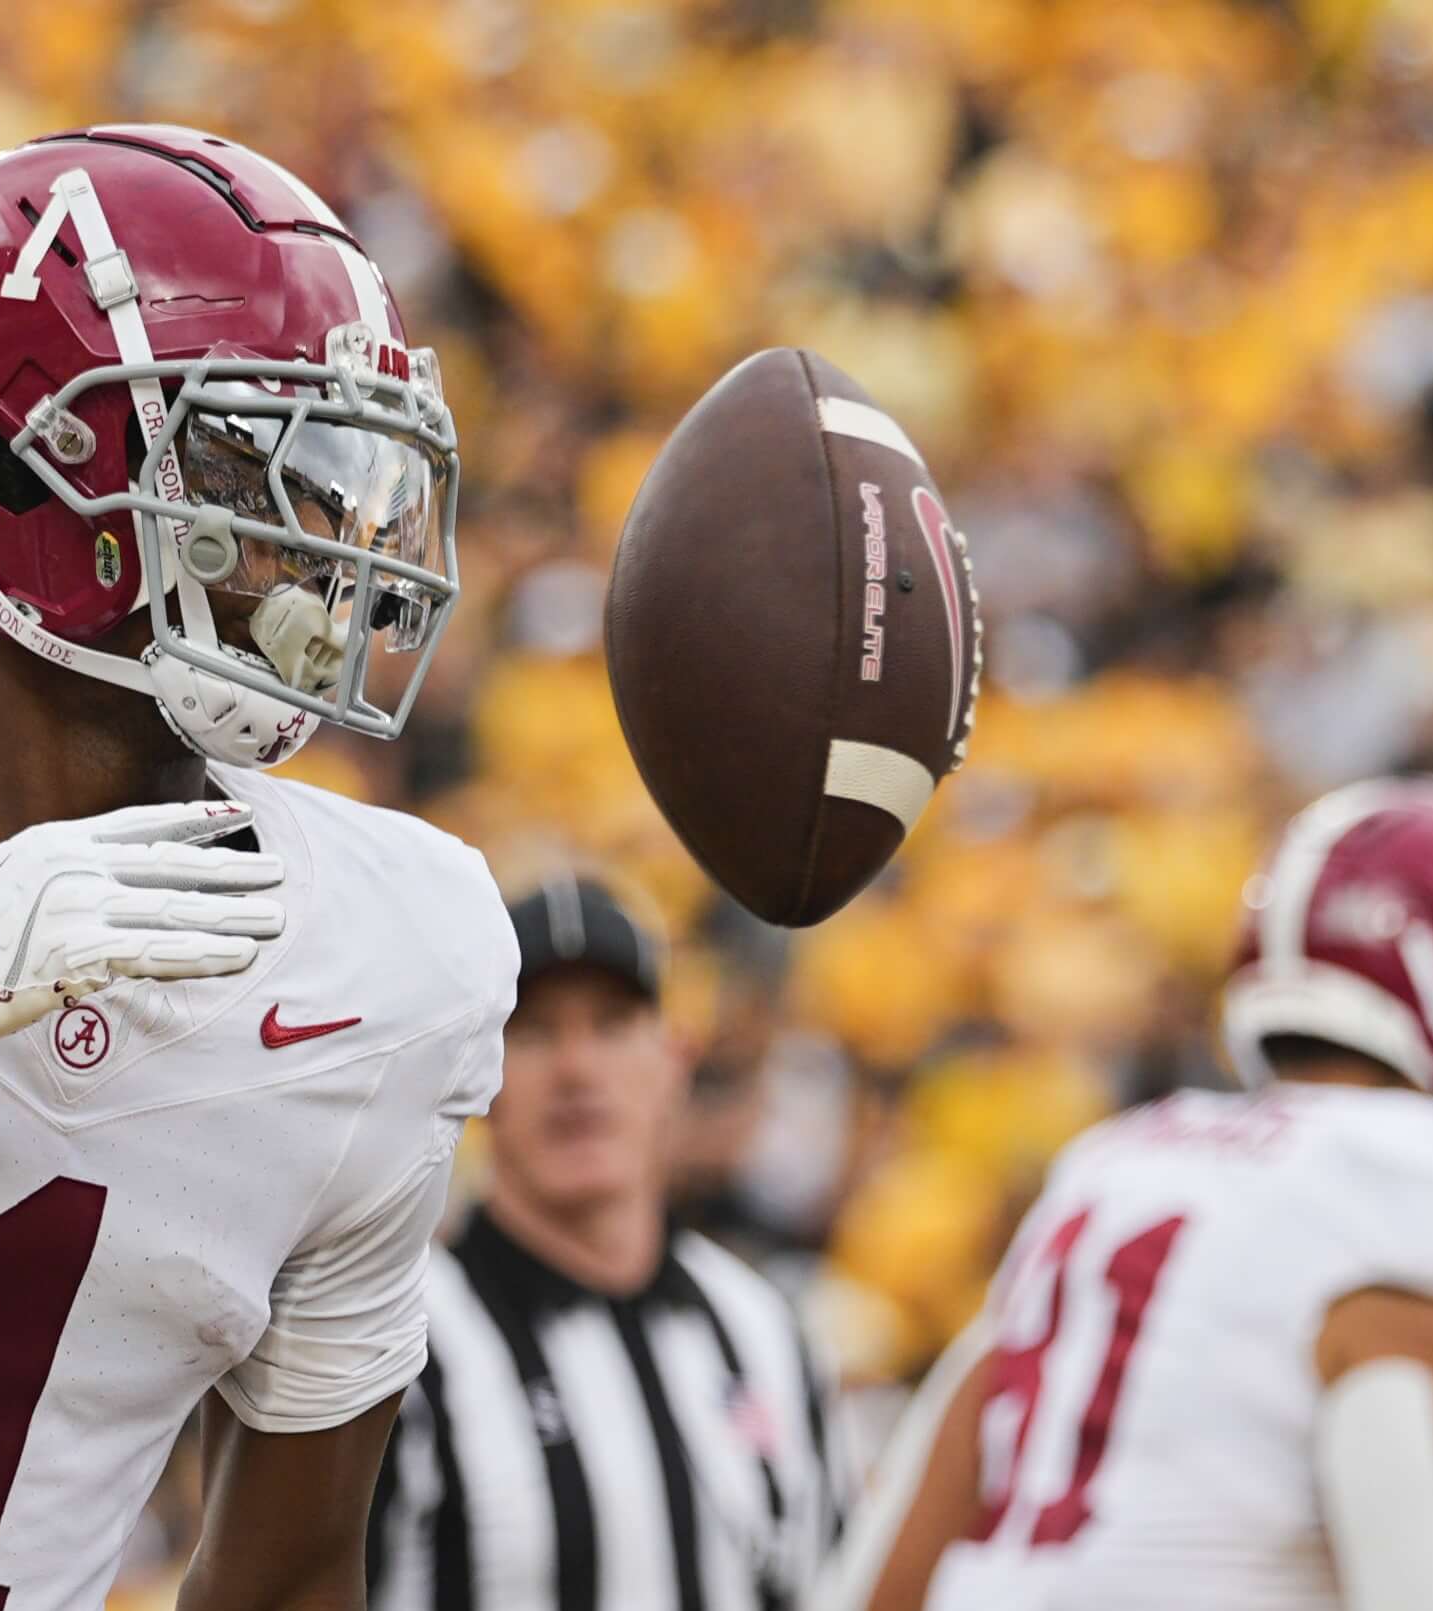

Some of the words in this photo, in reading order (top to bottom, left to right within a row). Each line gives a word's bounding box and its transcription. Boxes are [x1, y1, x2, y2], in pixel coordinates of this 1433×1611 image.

[376, 343, 411, 383] AM
[142, 400, 183, 504] CRSON
[859, 482, 887, 580] VAPOR
[861, 582, 885, 682] ELITE
